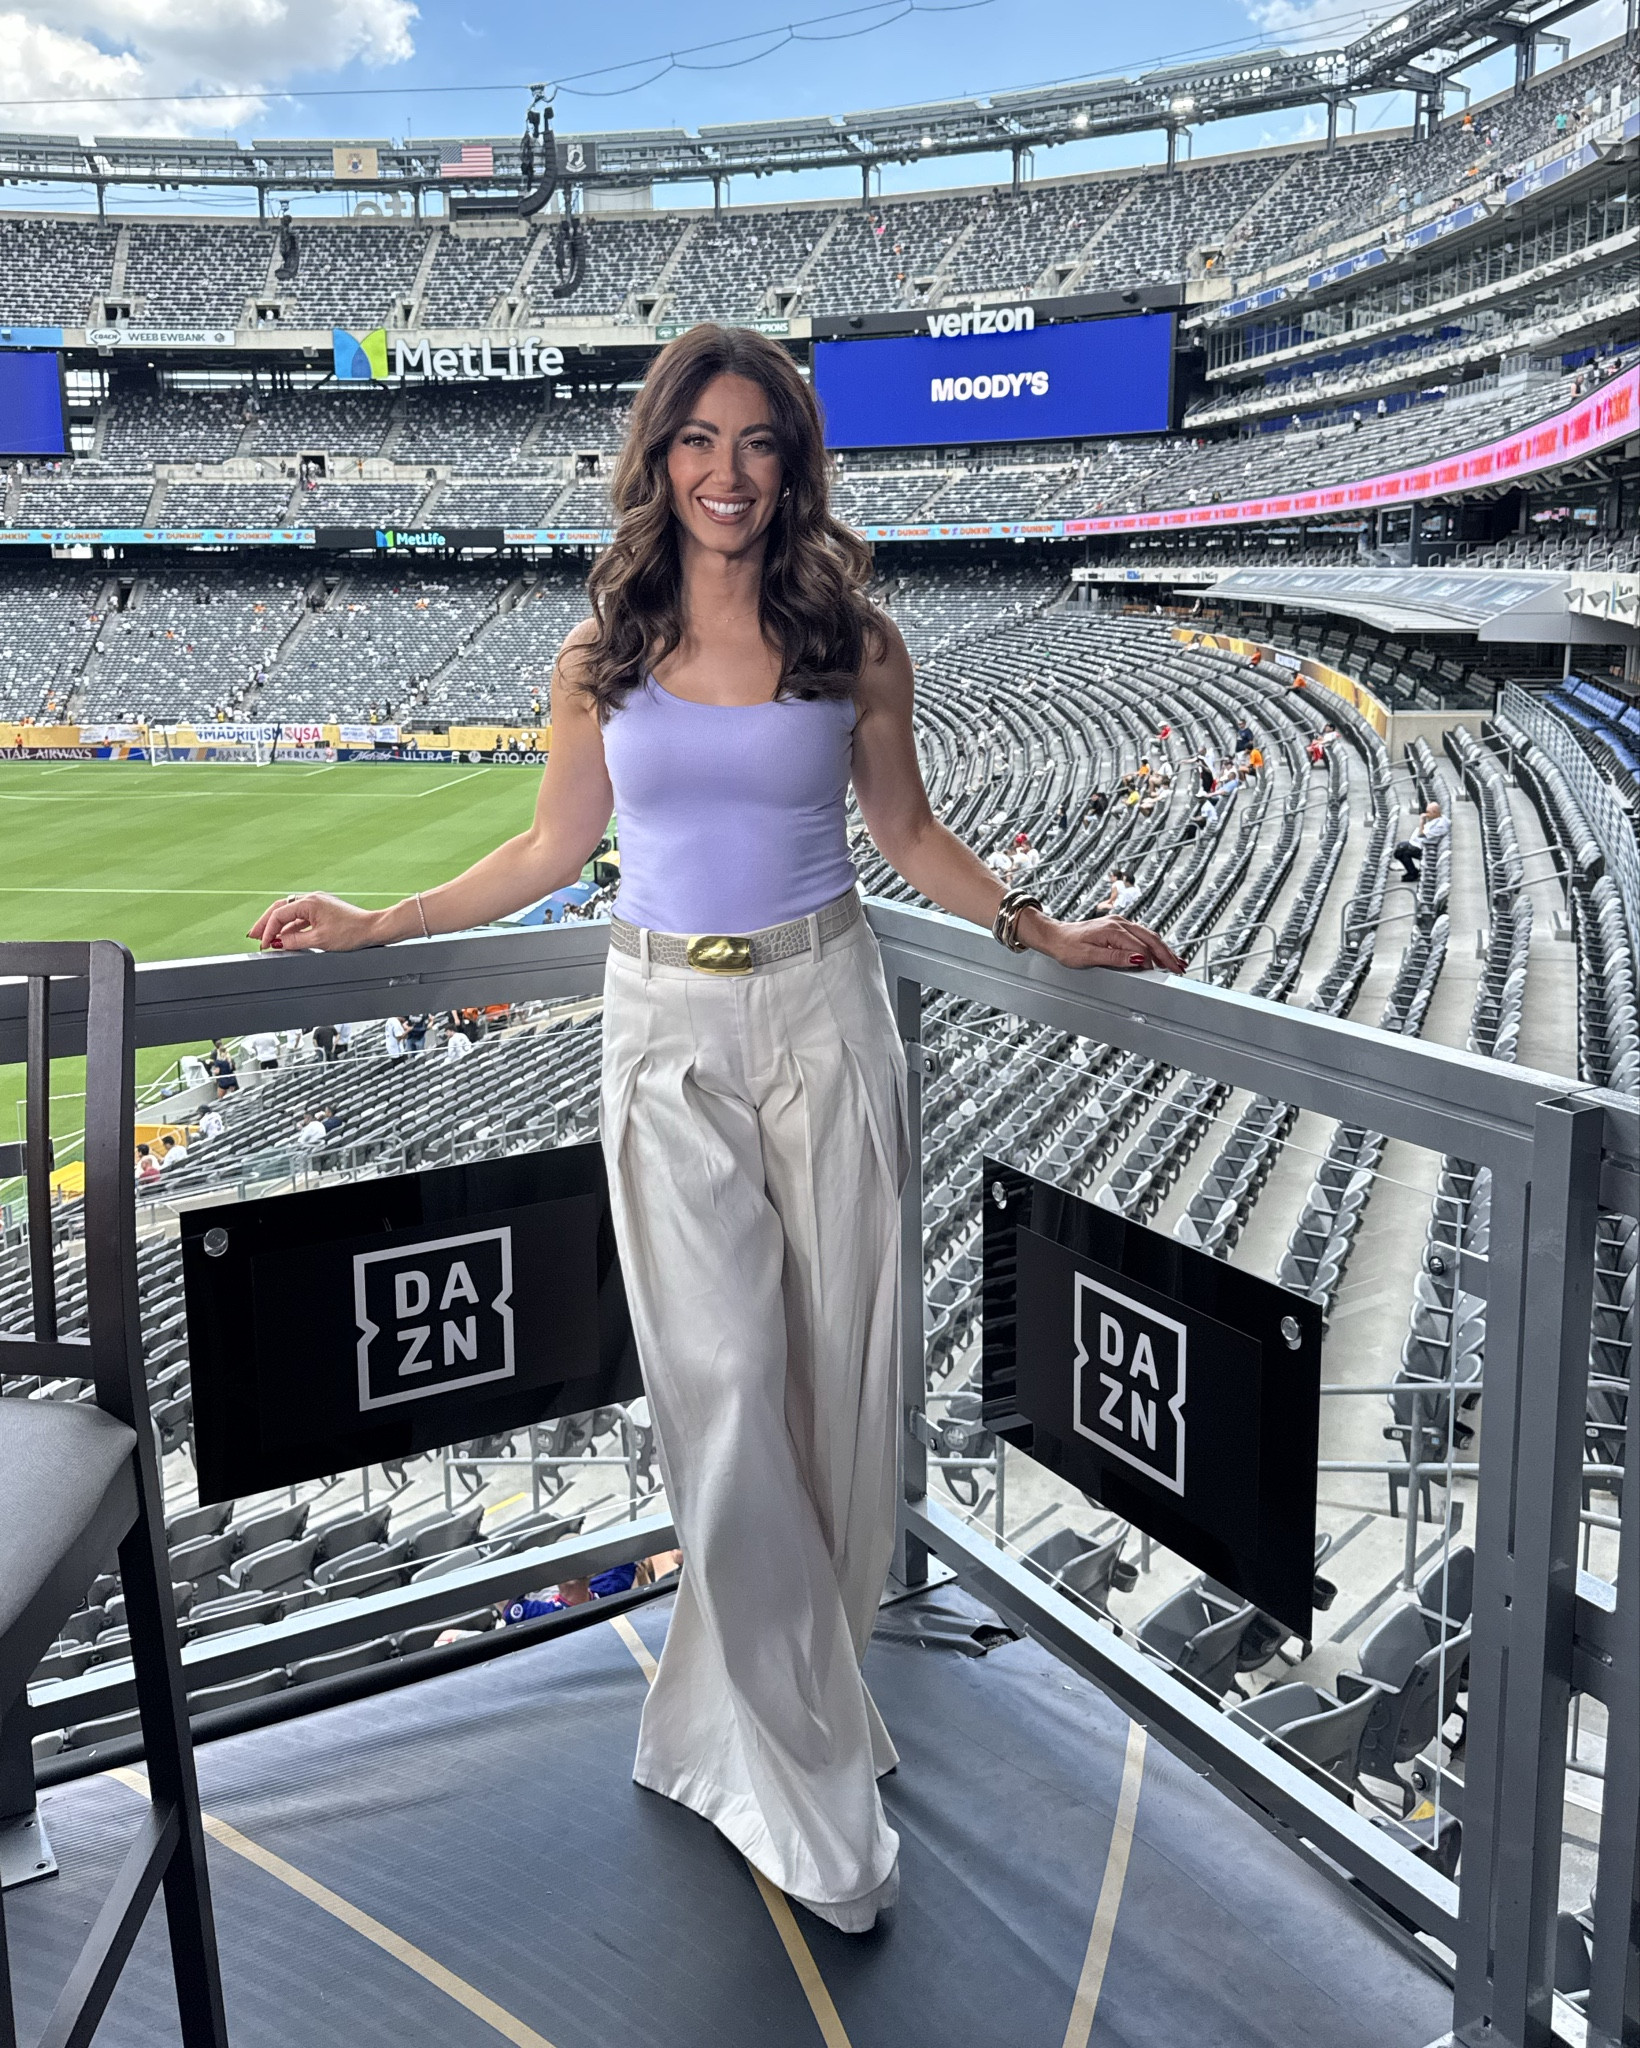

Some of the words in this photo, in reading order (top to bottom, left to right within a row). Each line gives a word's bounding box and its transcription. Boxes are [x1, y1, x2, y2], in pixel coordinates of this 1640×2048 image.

[926, 303, 1035, 339] verizon
[94, 333, 118, 341] COACH
[128, 332, 159, 342] WEEB
[160, 332, 206, 342] EWBANK
[395, 336, 565, 377] MetLife
[930, 370, 1049, 402] MOODY'S
[396, 532, 446, 546] MetLife
[36, 748, 92, 760] AIRWAYS
[402, 750, 445, 761] ULTRA
